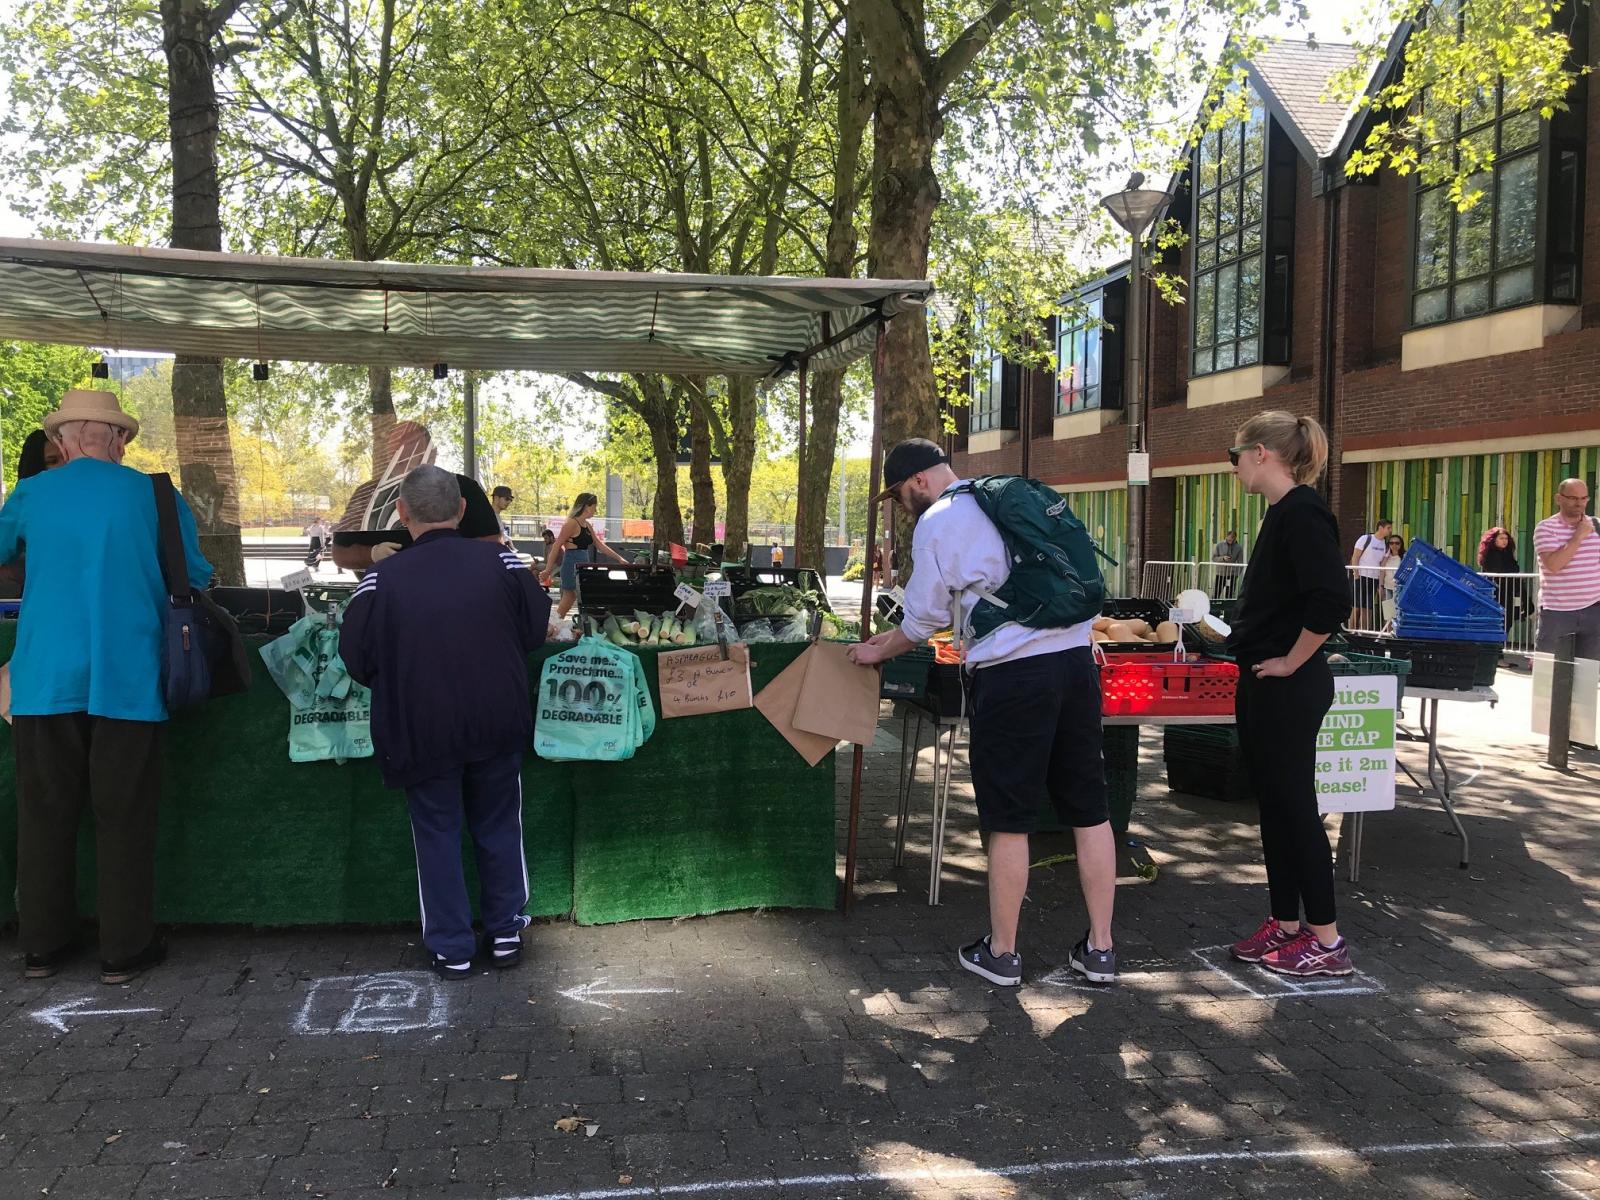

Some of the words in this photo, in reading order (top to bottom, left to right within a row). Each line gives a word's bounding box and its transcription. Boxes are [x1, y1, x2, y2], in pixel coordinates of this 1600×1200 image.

[557, 653, 587, 665] Save
[294, 710, 370, 725] DEGRADABLE
[541, 709, 623, 725] DEGRADABLE
[1340, 731, 1380, 747] GAP
[1338, 757, 1352, 772] it
[1360, 757, 1388, 771] 2m
